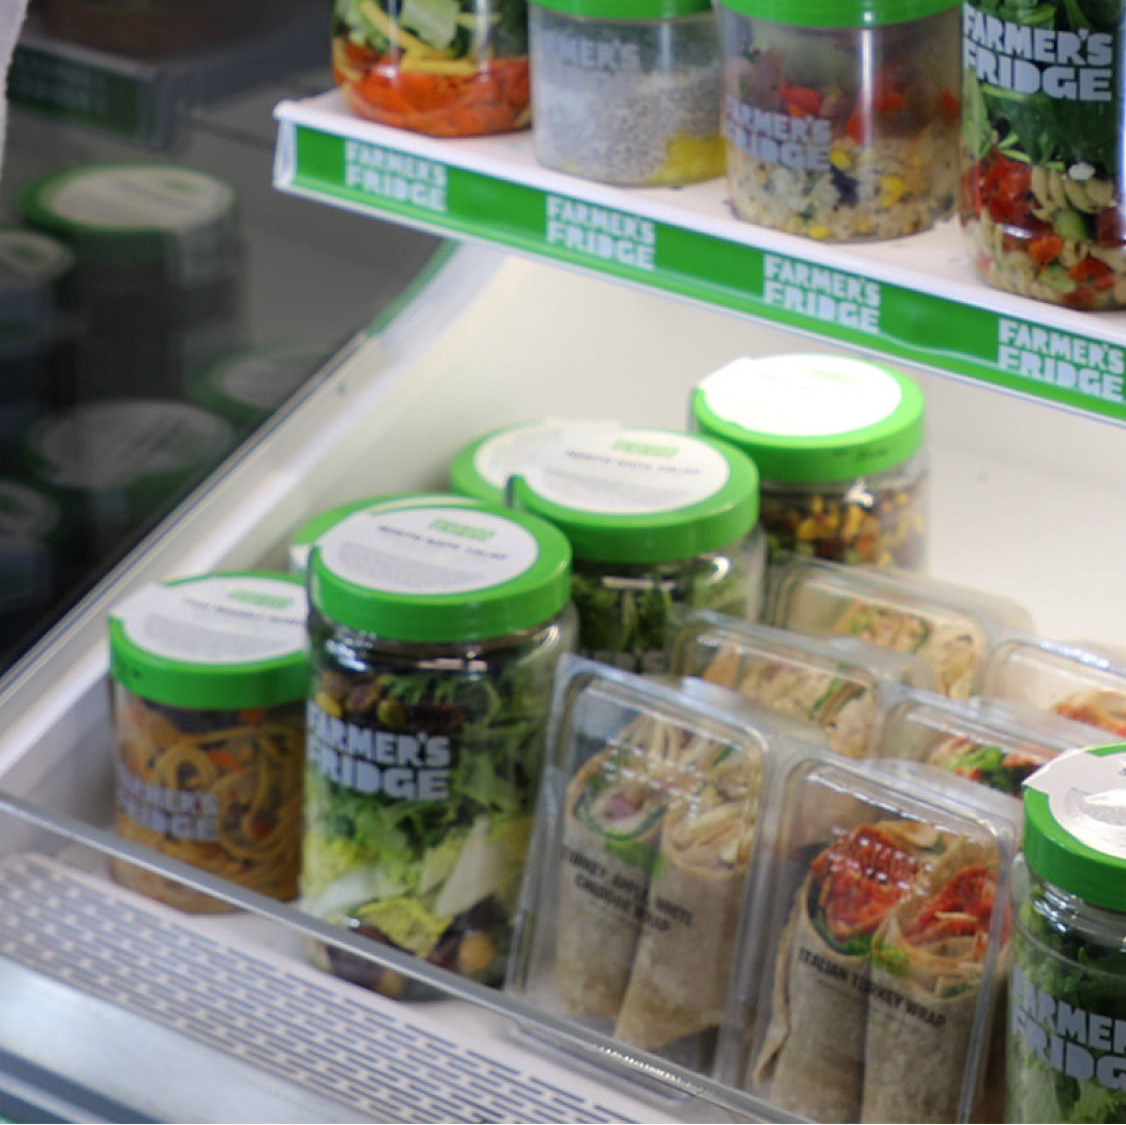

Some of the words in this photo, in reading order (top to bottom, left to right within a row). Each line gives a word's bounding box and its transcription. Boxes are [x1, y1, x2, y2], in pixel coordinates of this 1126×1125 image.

[963, 2, 1114, 66] FARMER'S
[963, 40, 1113, 102] FRIDGE
[344, 140, 447, 187] FARMER'S
[344, 166, 448, 213] FRIDGE
[546, 194, 656, 245] FARMER'S
[546, 220, 656, 270] FRIDGE
[763, 253, 881, 308] FARMER'S
[763, 279, 880, 333] FRIDGE
[998, 344, 1125, 403] FRIDGE
[999, 318, 1125, 374] FARMER'S
[307, 706, 450, 768] FARMER'S
[307, 742, 450, 801] FRIDGE
[798, 947, 848, 986] ITALIAN
[847, 970, 904, 1009] TURKEY
[904, 996, 946, 1028] WRAP
